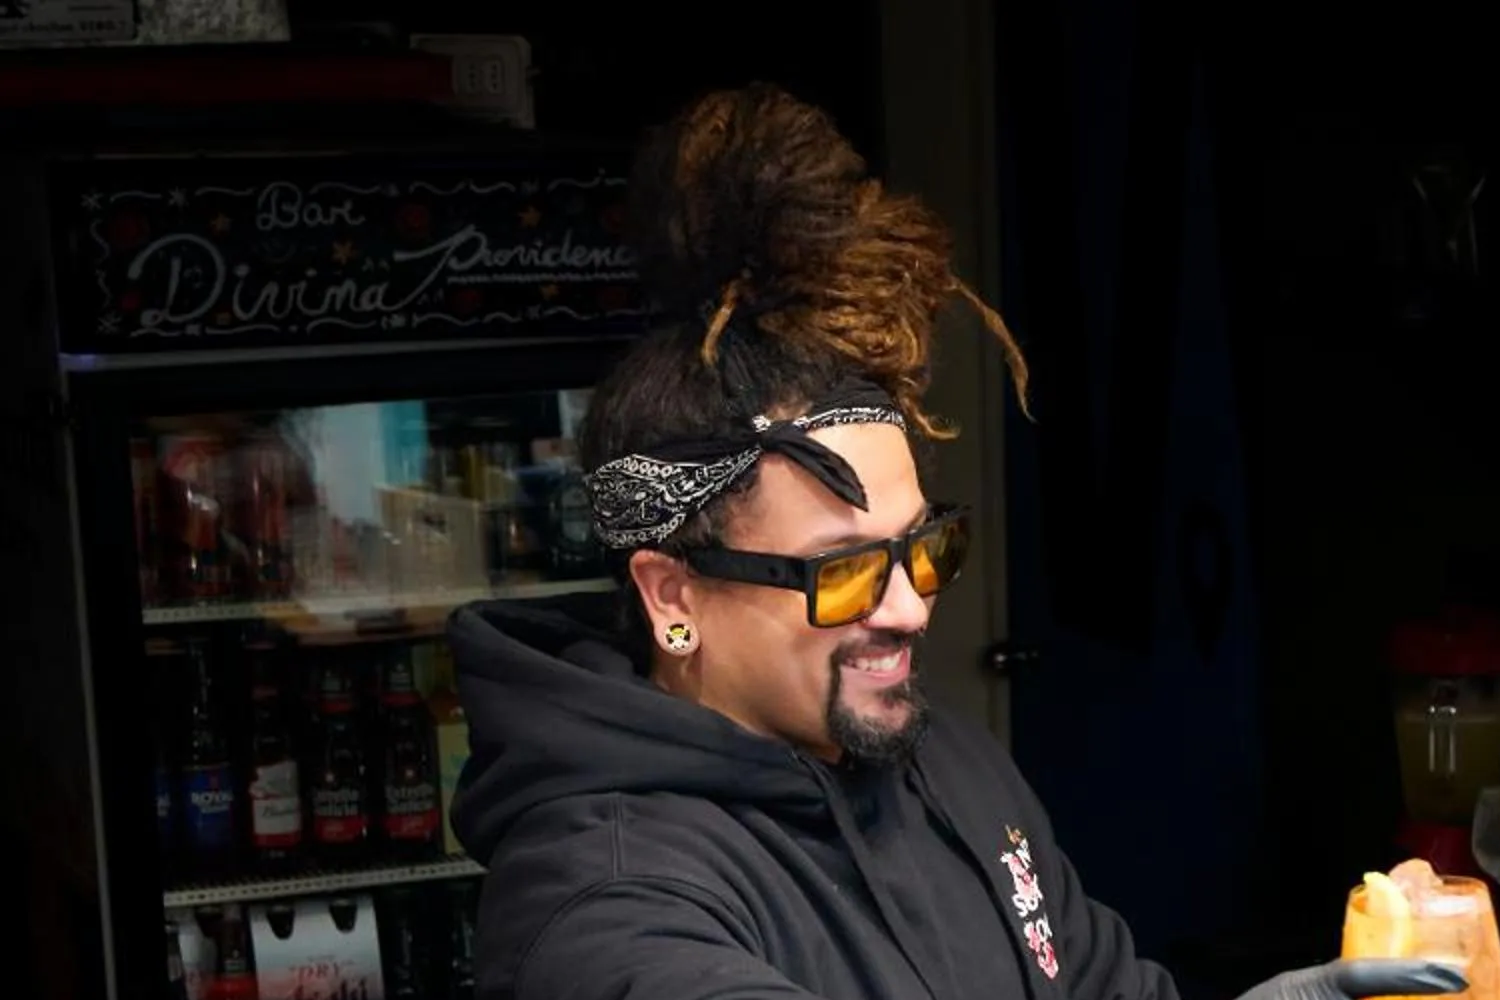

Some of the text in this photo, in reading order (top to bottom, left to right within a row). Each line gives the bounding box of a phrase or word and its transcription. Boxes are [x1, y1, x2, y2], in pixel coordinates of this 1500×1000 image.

[256, 181, 365, 231] Bar
[127, 223, 640, 324] Divina Providenc
